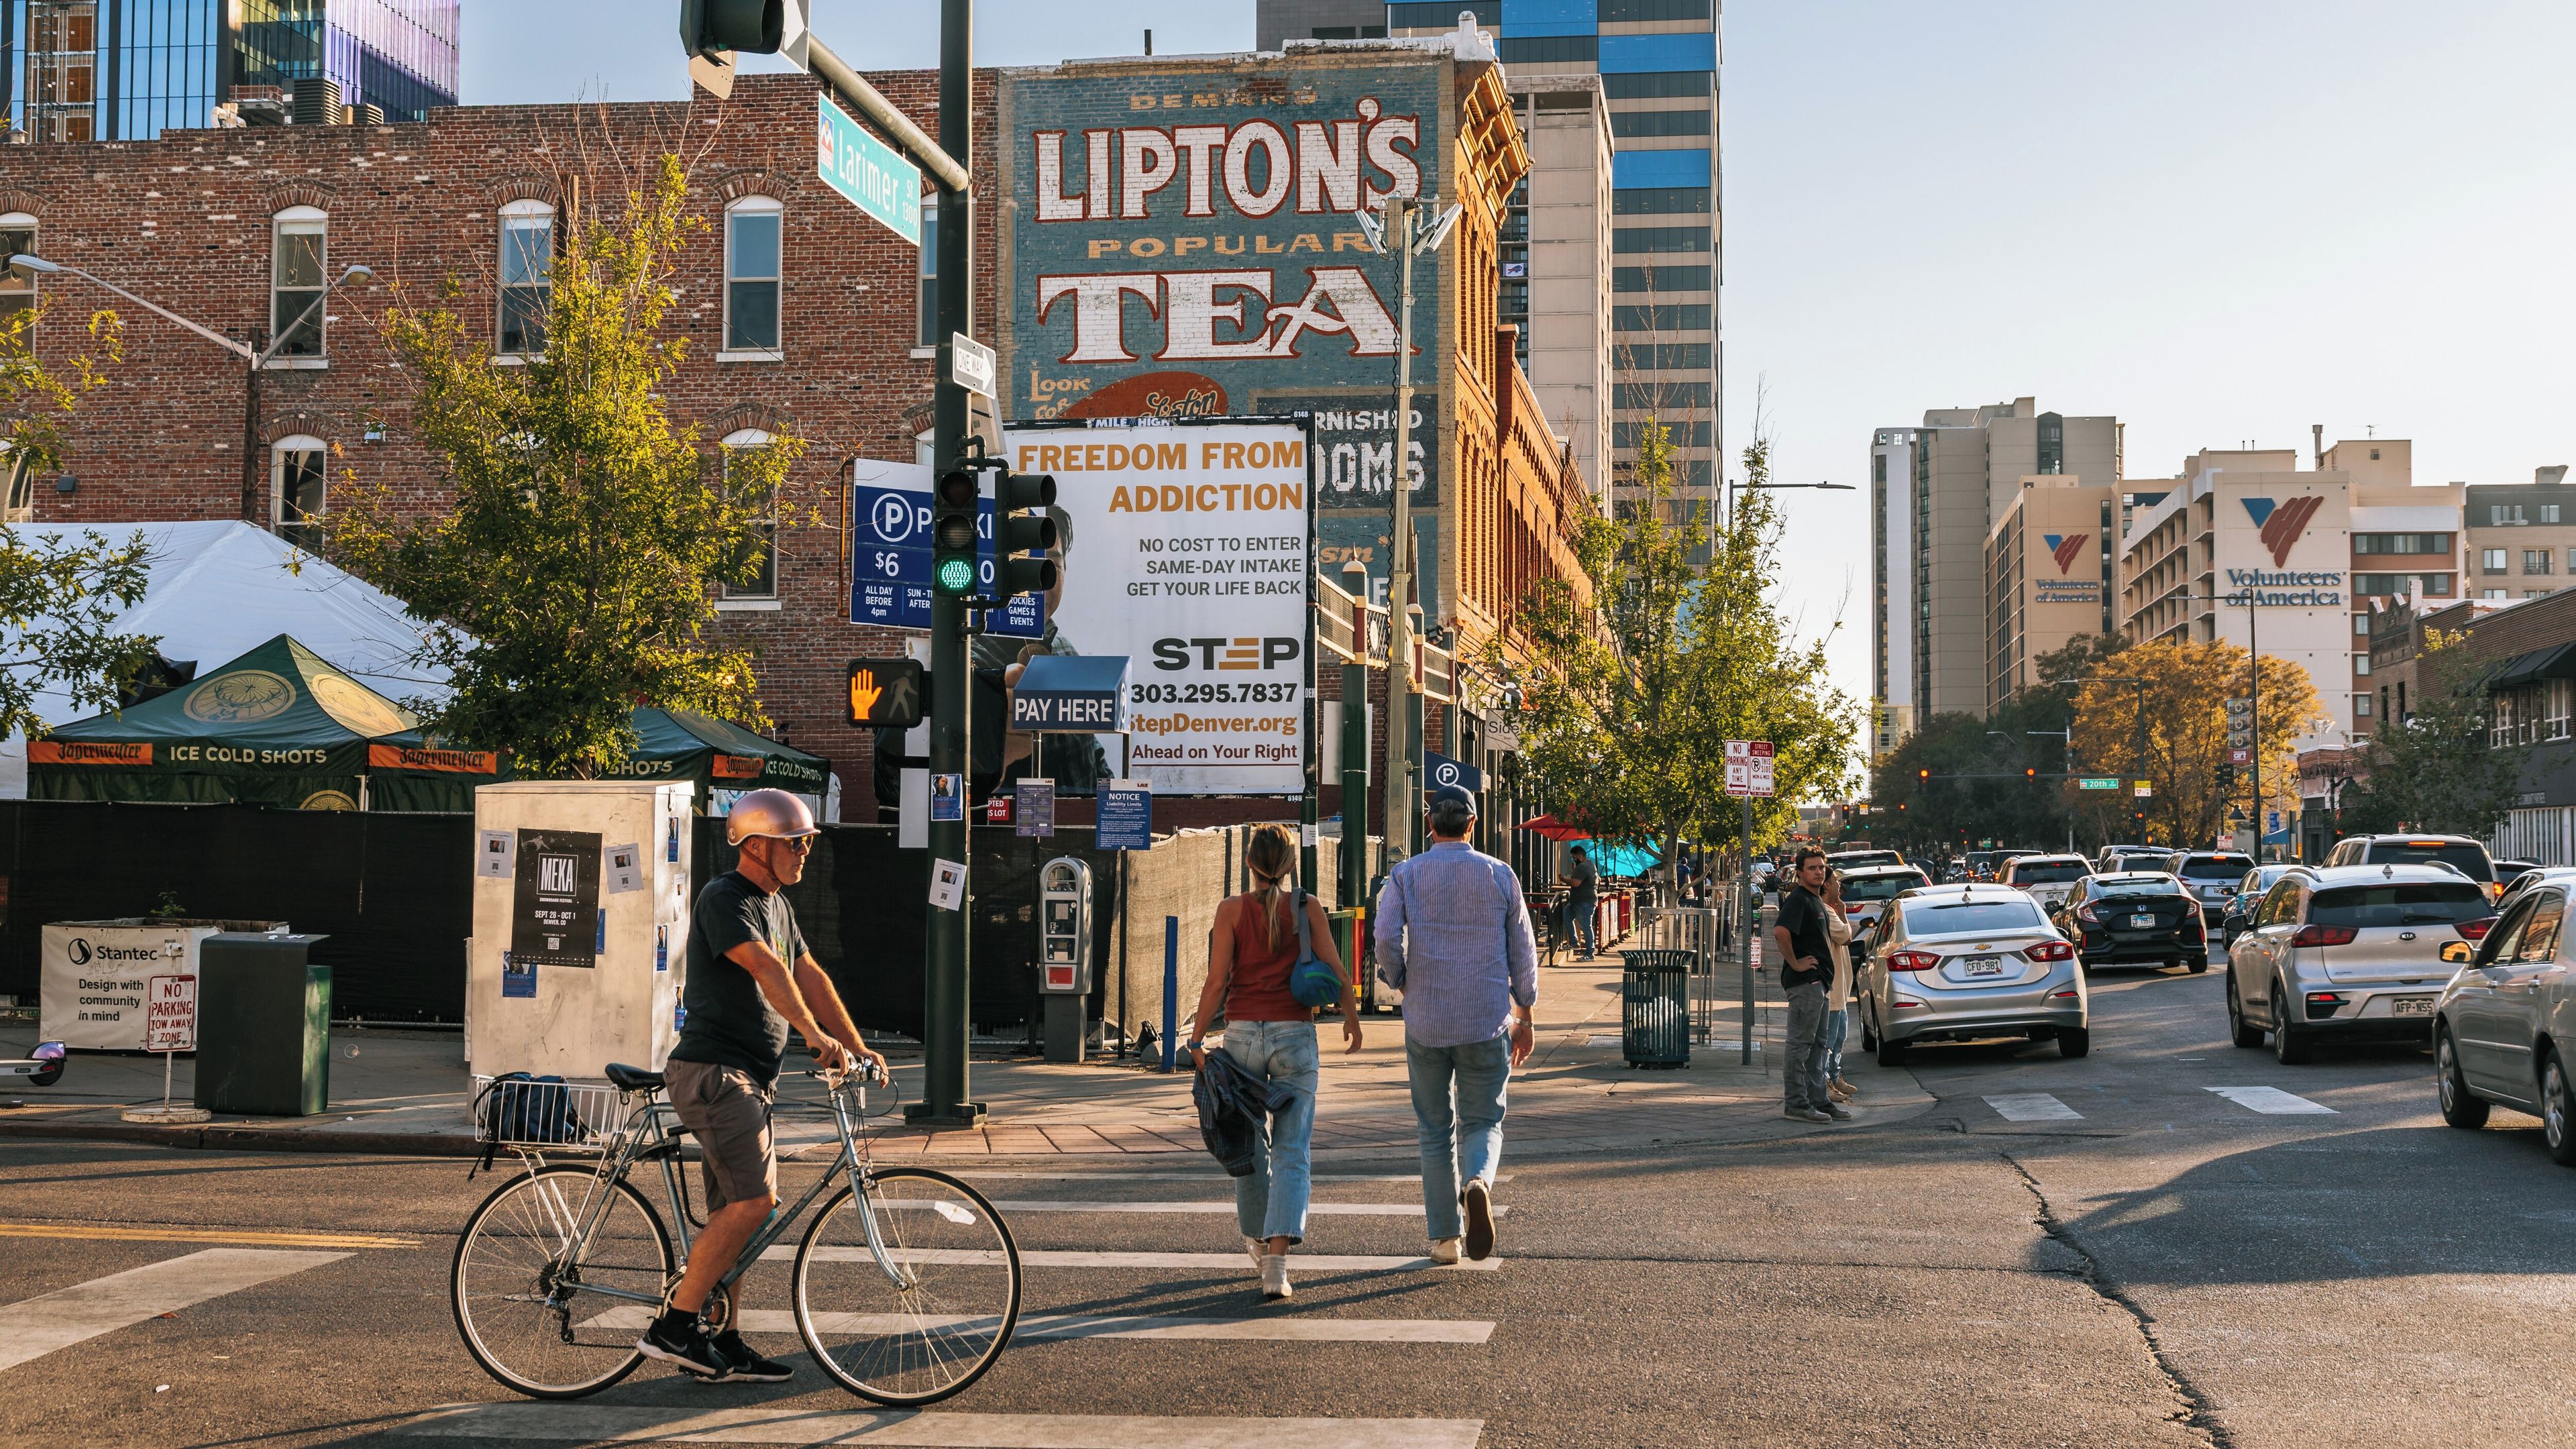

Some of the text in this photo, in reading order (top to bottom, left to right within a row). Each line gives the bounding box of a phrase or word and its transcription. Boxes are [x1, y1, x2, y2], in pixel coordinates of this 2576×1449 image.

[1032, 96, 1421, 223] LIPTON'S
[839, 129, 898, 216] Larimer
[907, 179, 914, 200] St
[902, 201, 918, 225] 1300
[1088, 233, 1375, 259] POPULAR
[1036, 266, 1421, 365] TEA
[959, 350, 983, 378] ONE WAY
[1095, 418, 1128, 427] MILE
[1018, 441, 1303, 472] FREEDOM FROM
[1108, 483, 1303, 513] ADDICTION
[1140, 537, 1301, 552] NO COST TO ENTER
[875, 551, 900, 577] $6
[1146, 559, 1301, 574] SAME-DAY INTAKE
[2035, 579, 2100, 590] Volunteers
[2226, 569, 2341, 586] Volunteers
[865, 586, 893, 596] ALL DAY
[907, 588, 921, 598] SUN
[1127, 581, 1301, 596] GET YOUR LIFE BACK
[865, 596, 892, 606] BEFORE
[909, 599, 930, 608] AFTER
[1009, 596, 1035, 606] ROCKIES
[2035, 592, 2100, 602] of America
[2226, 588, 2341, 606] of America
[871, 607, 887, 616] 4pm
[1008, 606, 1030, 615] GAMES
[1010, 617, 1034, 626] EVENTS
[1152, 637, 1300, 671] STEP
[1131, 683, 1298, 704] 303.295.7837
[1015, 698, 1113, 722] PAY HERE
[170, 747, 327, 764] ICE COLD SHOTS
[1132, 743, 1297, 761] Ahead on Your Right
[1733, 744, 1741, 754] NO
[1727, 756, 1748, 767] PARKING
[765, 760, 822, 782] ICE COLD SHOTS
[540, 857, 574, 892] MEKA
[535, 910, 549, 918] SEPT
[97, 946, 158, 961] Stantec
[79, 979, 144, 992] Design with
[164, 983, 182, 998] NO
[79, 996, 141, 1008] community
[151, 1000, 193, 1016] PARKING
[78, 1010, 120, 1022] in mind
[151, 1018, 192, 1030] TOW AWAY
[160, 1032, 182, 1042] ZONE
